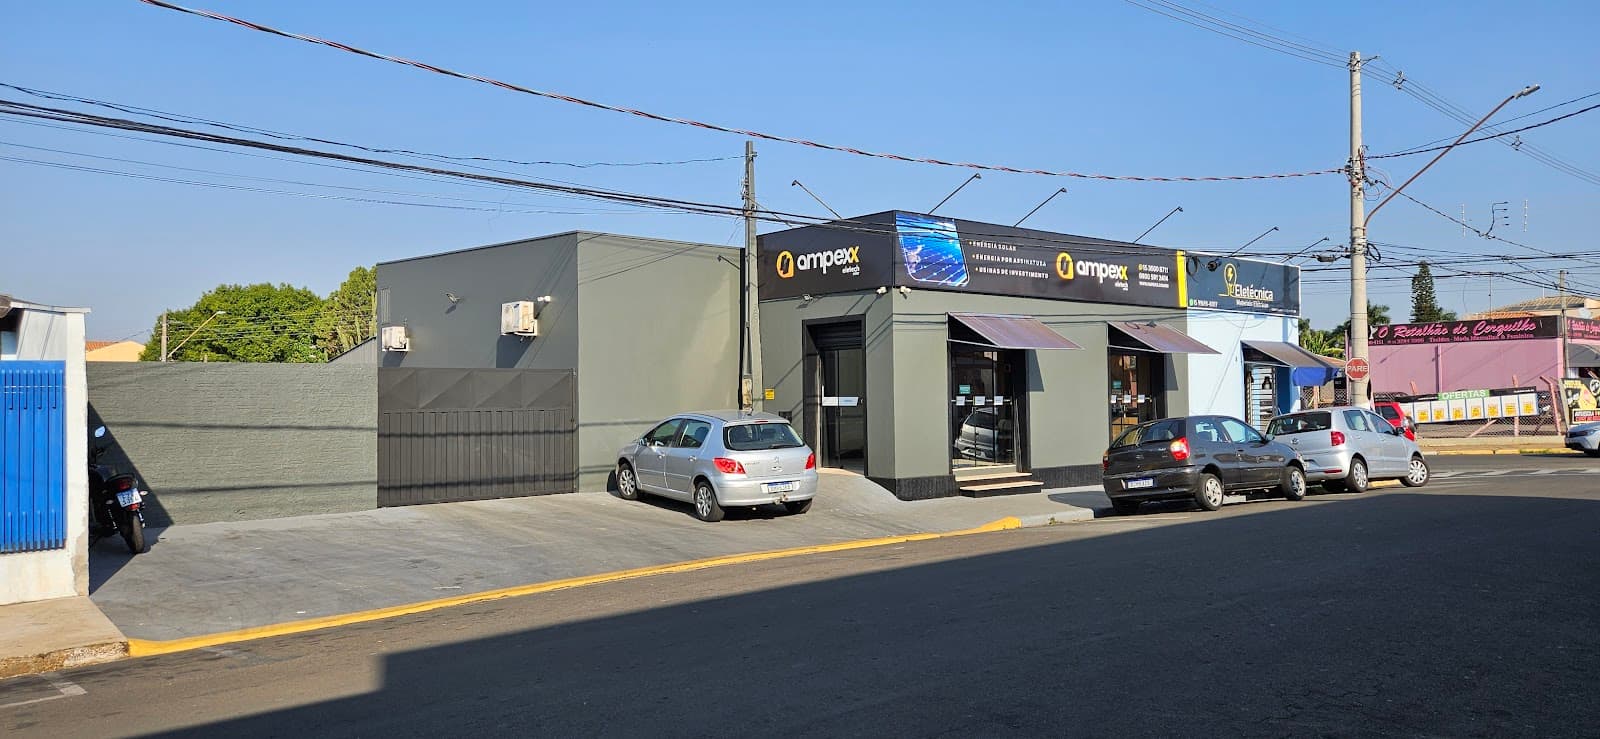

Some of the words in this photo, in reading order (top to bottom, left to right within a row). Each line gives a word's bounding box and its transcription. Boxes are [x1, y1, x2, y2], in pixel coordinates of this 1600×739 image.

[797, 246, 860, 275] ampexx
[975, 254, 1000, 262] ENERGIA
[1076, 259, 1129, 283] ampexx
[1235, 284, 1274, 300] Eletécnica
[1378, 326, 1389, 338] O
[1394, 324, 1449, 338] Retalhão
[1452, 323, 1468, 335] de
[1473, 318, 1537, 337] Cerquilho
[1347, 365, 1368, 373] PARE
[1443, 390, 1486, 399] OFERTAS
